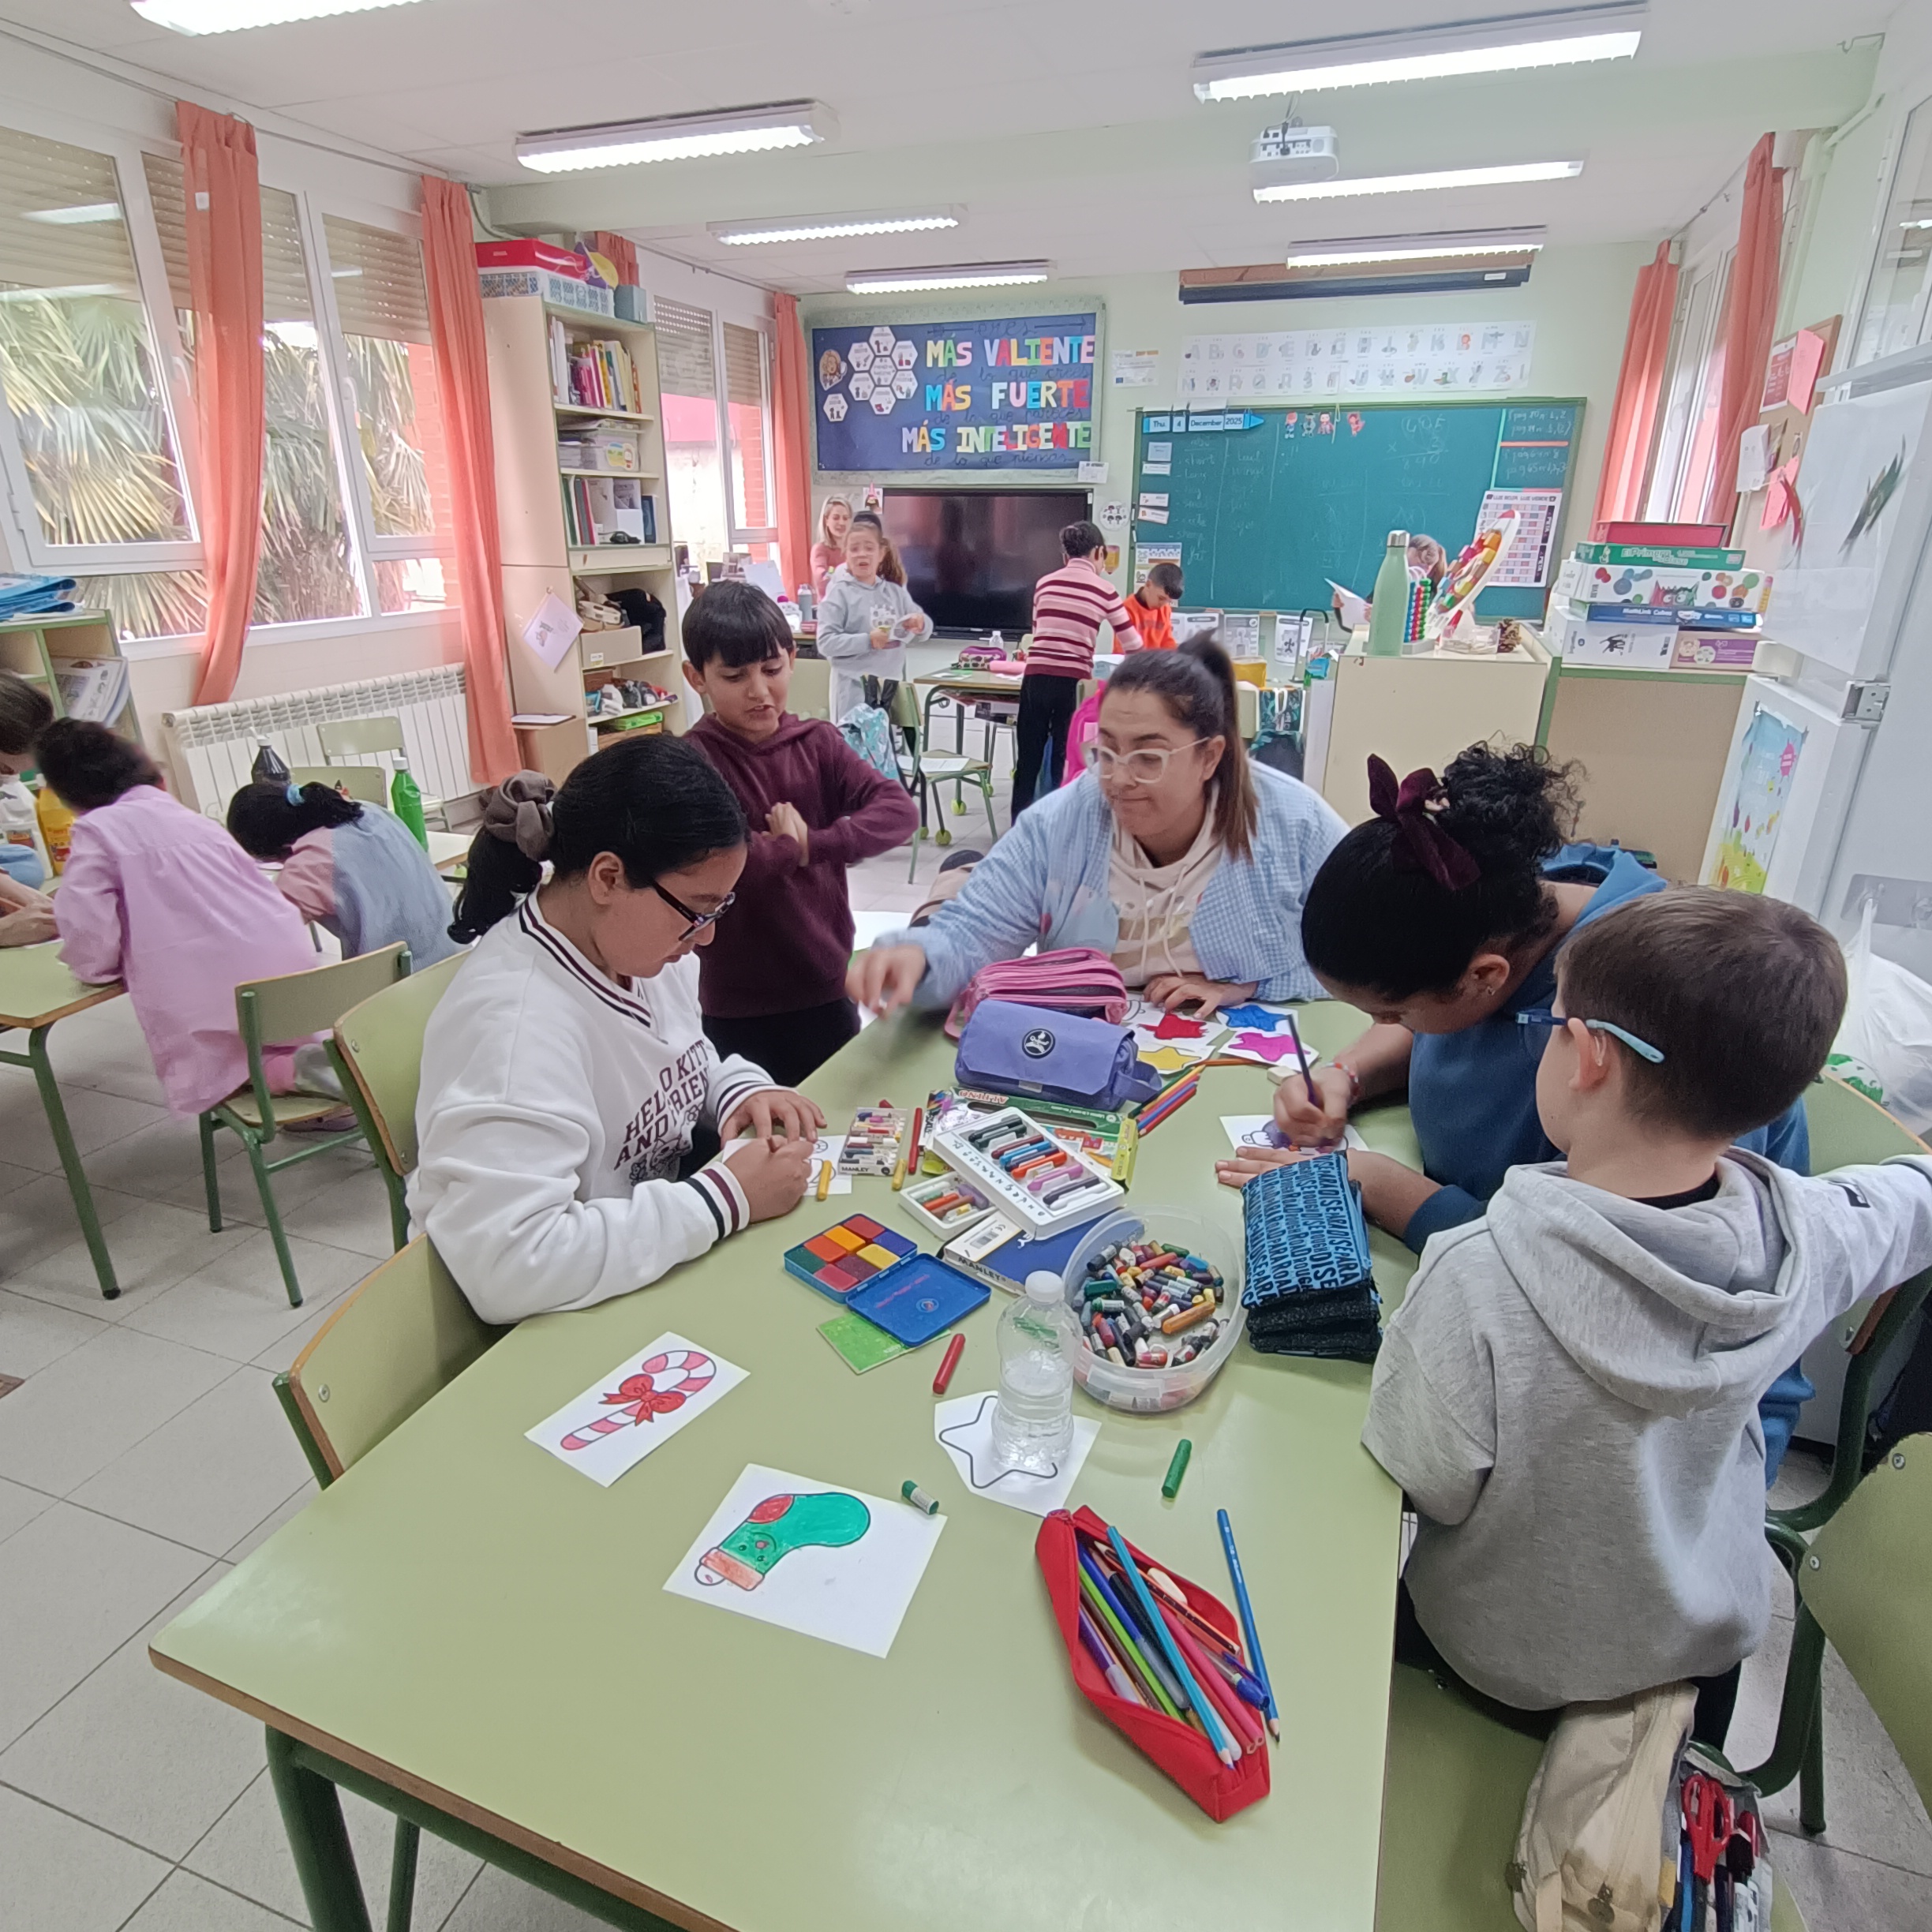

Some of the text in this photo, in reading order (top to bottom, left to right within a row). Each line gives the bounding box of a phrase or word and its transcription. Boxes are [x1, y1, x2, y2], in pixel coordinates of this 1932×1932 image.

[927, 333, 1095, 368] MÁS VALIENTE
[926, 379, 1089, 411] MÁS FUERTE
[901, 420, 1092, 453] MÁS INTELIGENTE
[623, 1039, 709, 1144] HELO KITT
[614, 1114, 668, 1170] AND
[958, 1256, 1002, 1281] MANLEY
